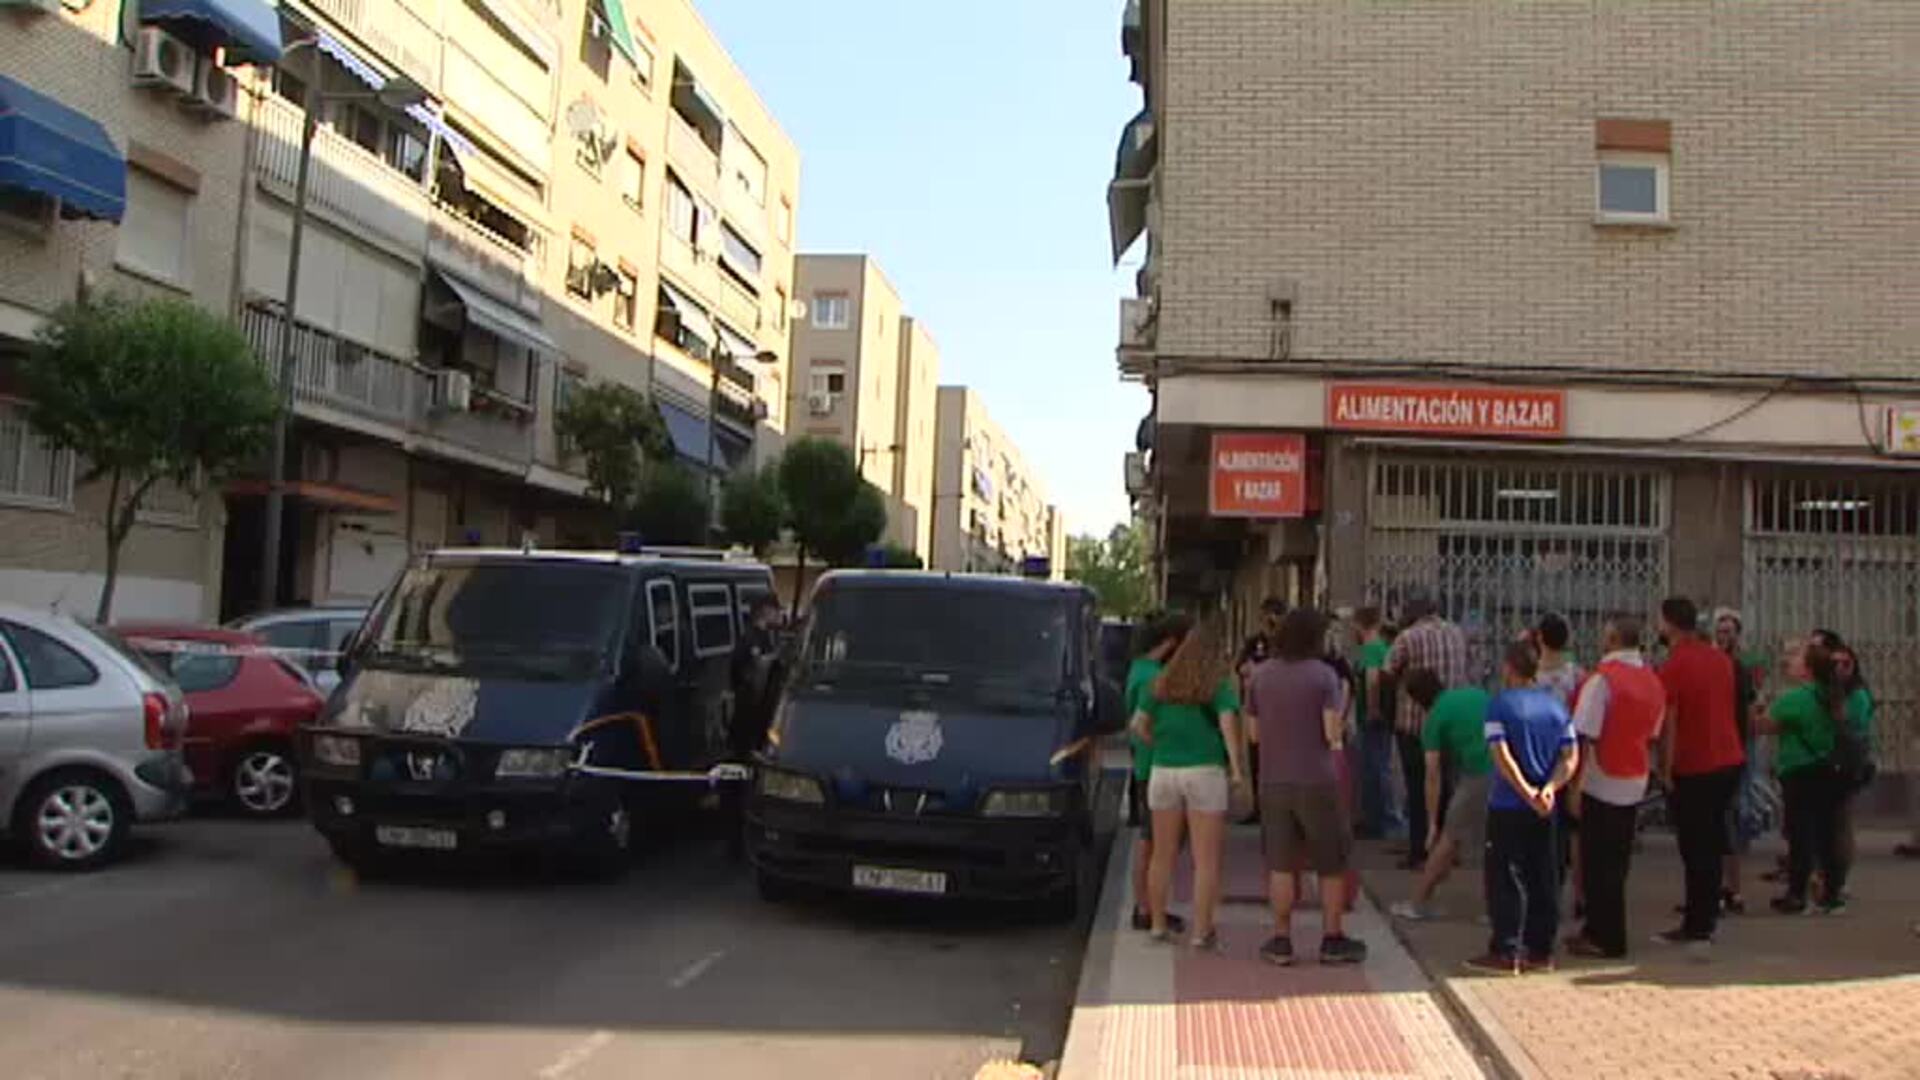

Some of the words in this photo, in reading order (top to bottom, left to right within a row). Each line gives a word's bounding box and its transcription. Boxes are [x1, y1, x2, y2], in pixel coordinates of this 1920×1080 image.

[1337, 391, 1473, 424] ALIMENTACIÓN
[1477, 400, 1490, 423] Y
[1493, 399, 1555, 427] BAZAR
[1218, 445, 1300, 471] ALIMENTACIÓN
[1243, 480, 1282, 500] BAZAR
